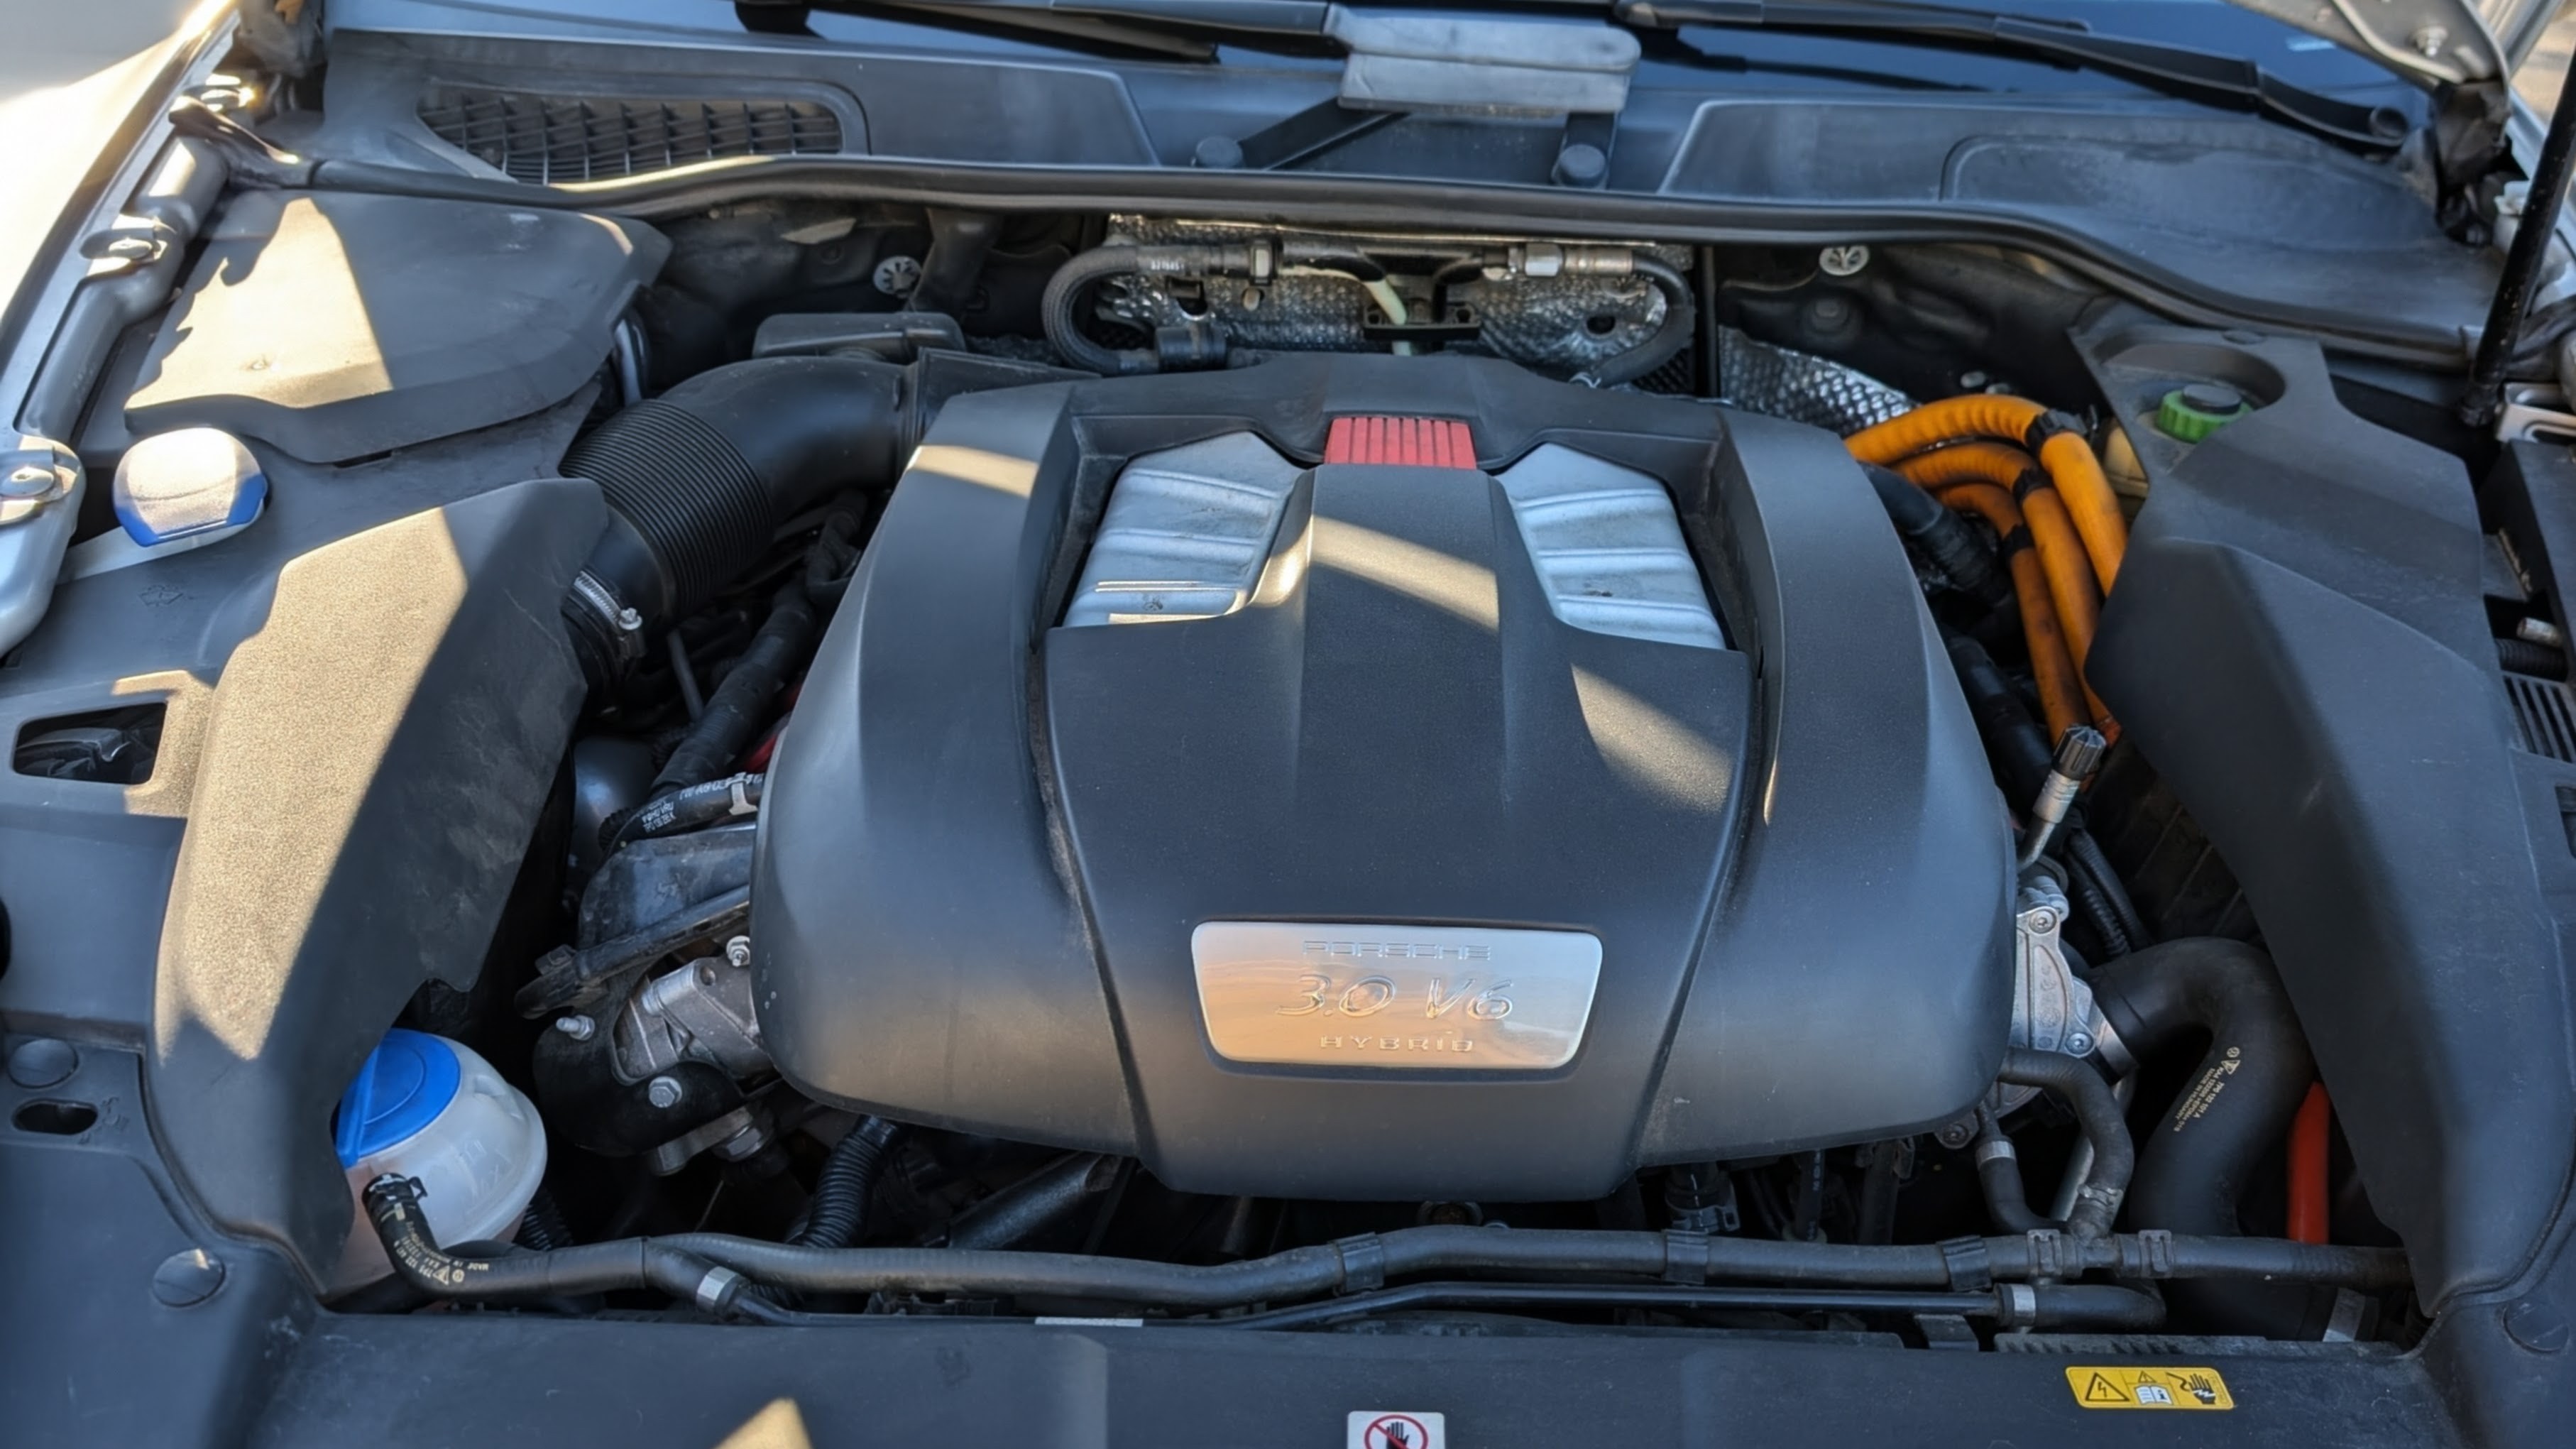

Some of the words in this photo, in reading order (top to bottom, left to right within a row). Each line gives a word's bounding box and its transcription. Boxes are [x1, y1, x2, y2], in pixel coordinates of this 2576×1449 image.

[1303, 940, 1492, 961] PORSCHE
[1276, 974, 1396, 1018] 3.0
[1426, 977, 1515, 1021] V6
[1320, 1035, 1474, 1053] HYBRID
[2175, 1091, 2198, 1119] HUNGARY
[2198, 1103, 2208, 1112] 101
[467, 1262, 489, 1270] MADE
